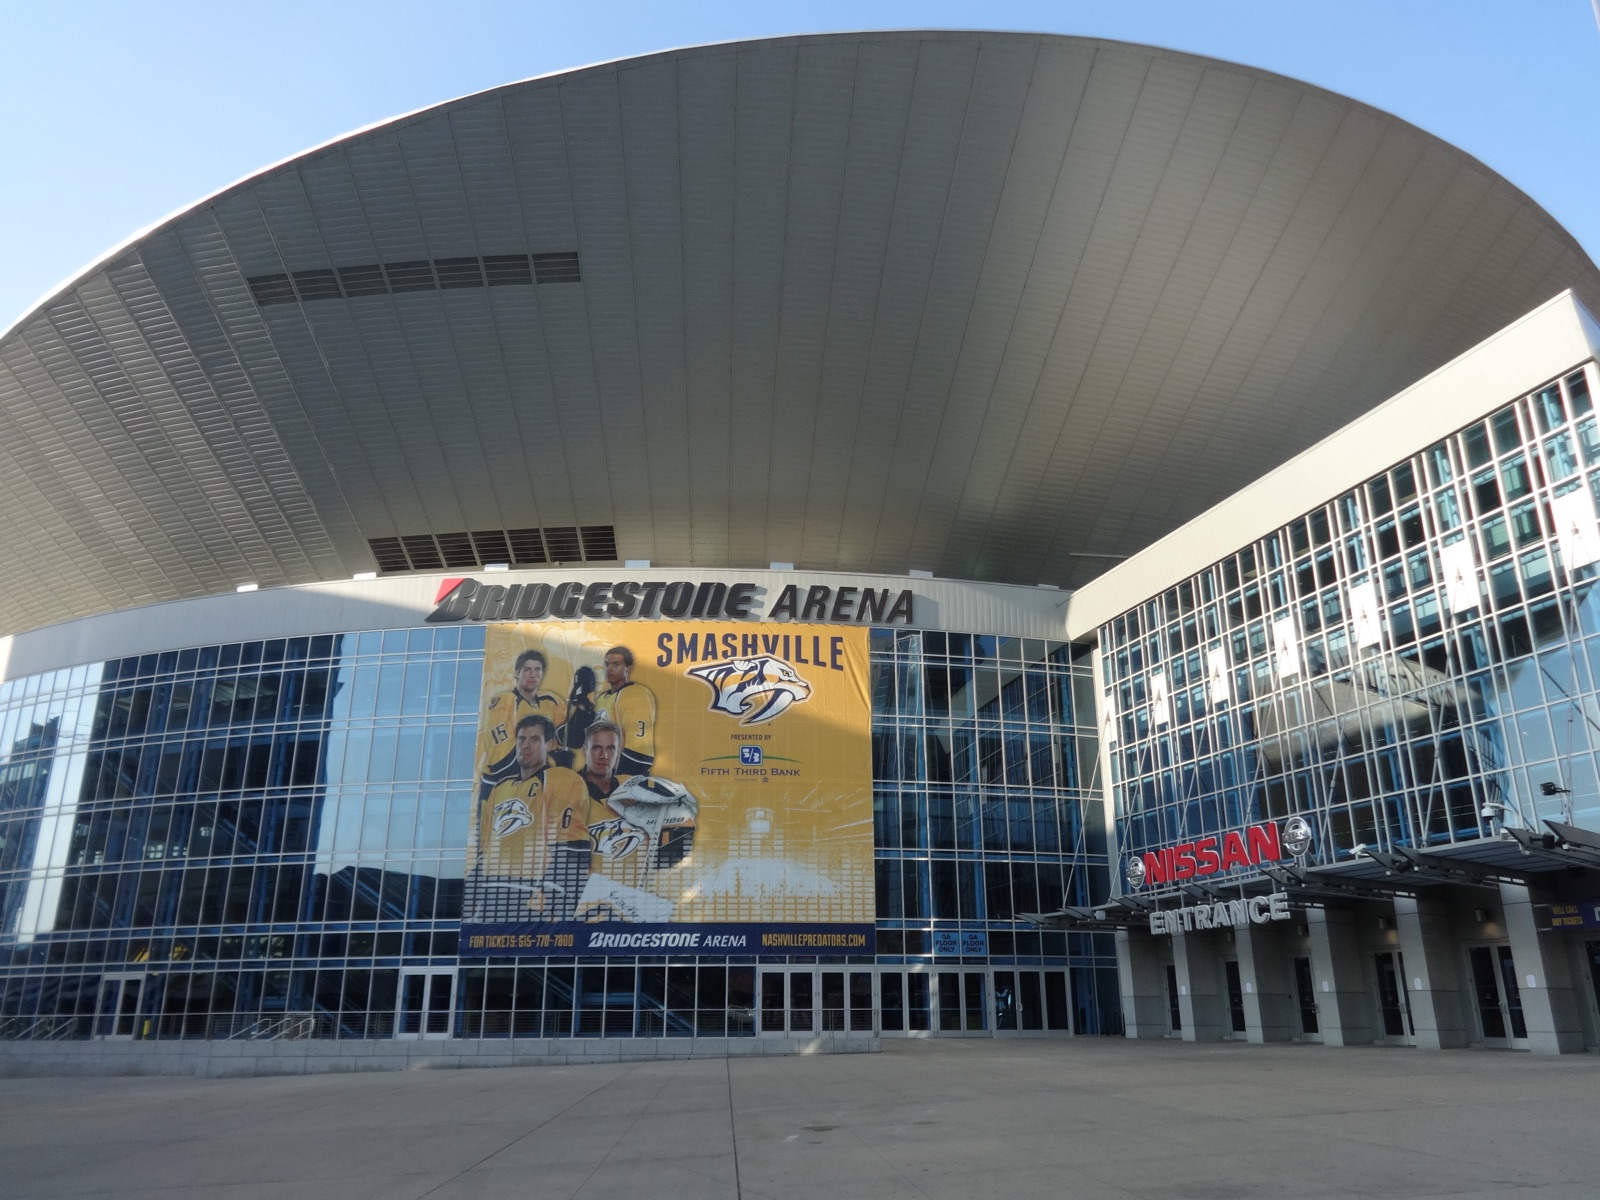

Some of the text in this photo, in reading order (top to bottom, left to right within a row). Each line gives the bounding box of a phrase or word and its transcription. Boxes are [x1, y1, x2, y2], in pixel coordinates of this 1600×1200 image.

[425, 578, 914, 625] BRIDGESTONE ARENA
[657, 632, 844, 672] SMASHVILLE
[491, 723, 509, 744] 15
[636, 720, 646, 738] 3
[700, 767, 800, 777] FIFTH THIRD BANK
[527, 782, 539, 798] C
[561, 807, 573, 829] 6
[1143, 821, 1282, 885] NISSAN
[1149, 892, 1291, 936] ENTRANCE
[469, 935, 484, 948] FOR
[485, 935, 517, 948] TICKETS:
[588, 932, 747, 948] BRIDGESTONE ARENA
[762, 933, 866, 947] NASHVILLEPREDATORS.COM
